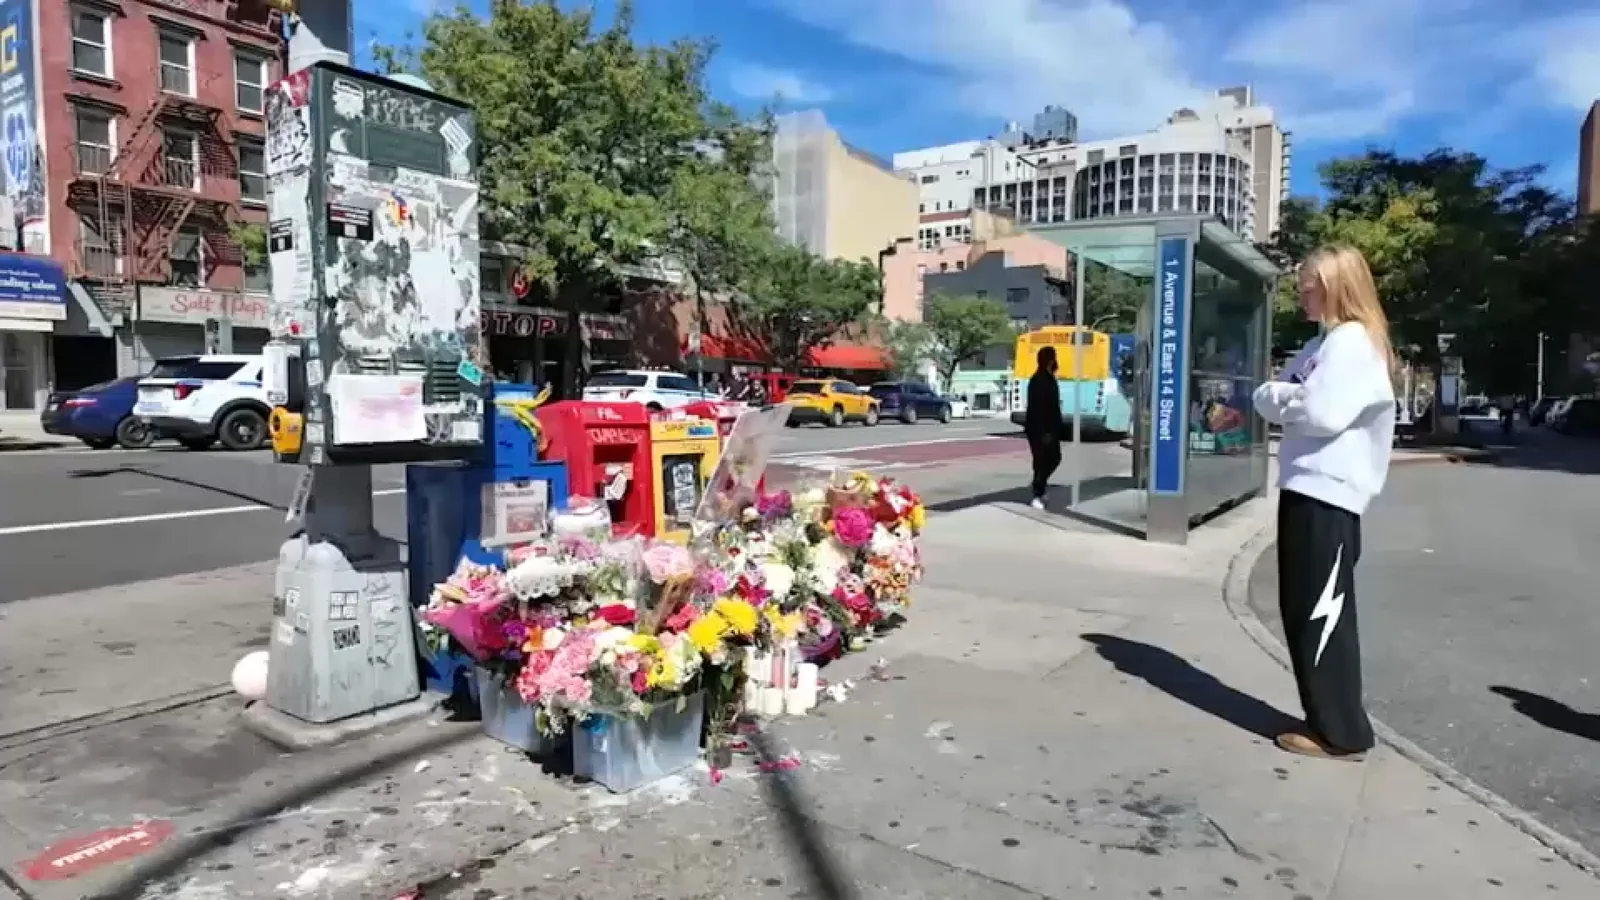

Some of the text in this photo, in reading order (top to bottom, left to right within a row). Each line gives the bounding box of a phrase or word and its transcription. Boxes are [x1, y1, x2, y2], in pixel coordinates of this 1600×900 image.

[170, 294, 214, 313] Salt
[1159, 257, 1179, 440] 1 Avenue & East 14 Street
